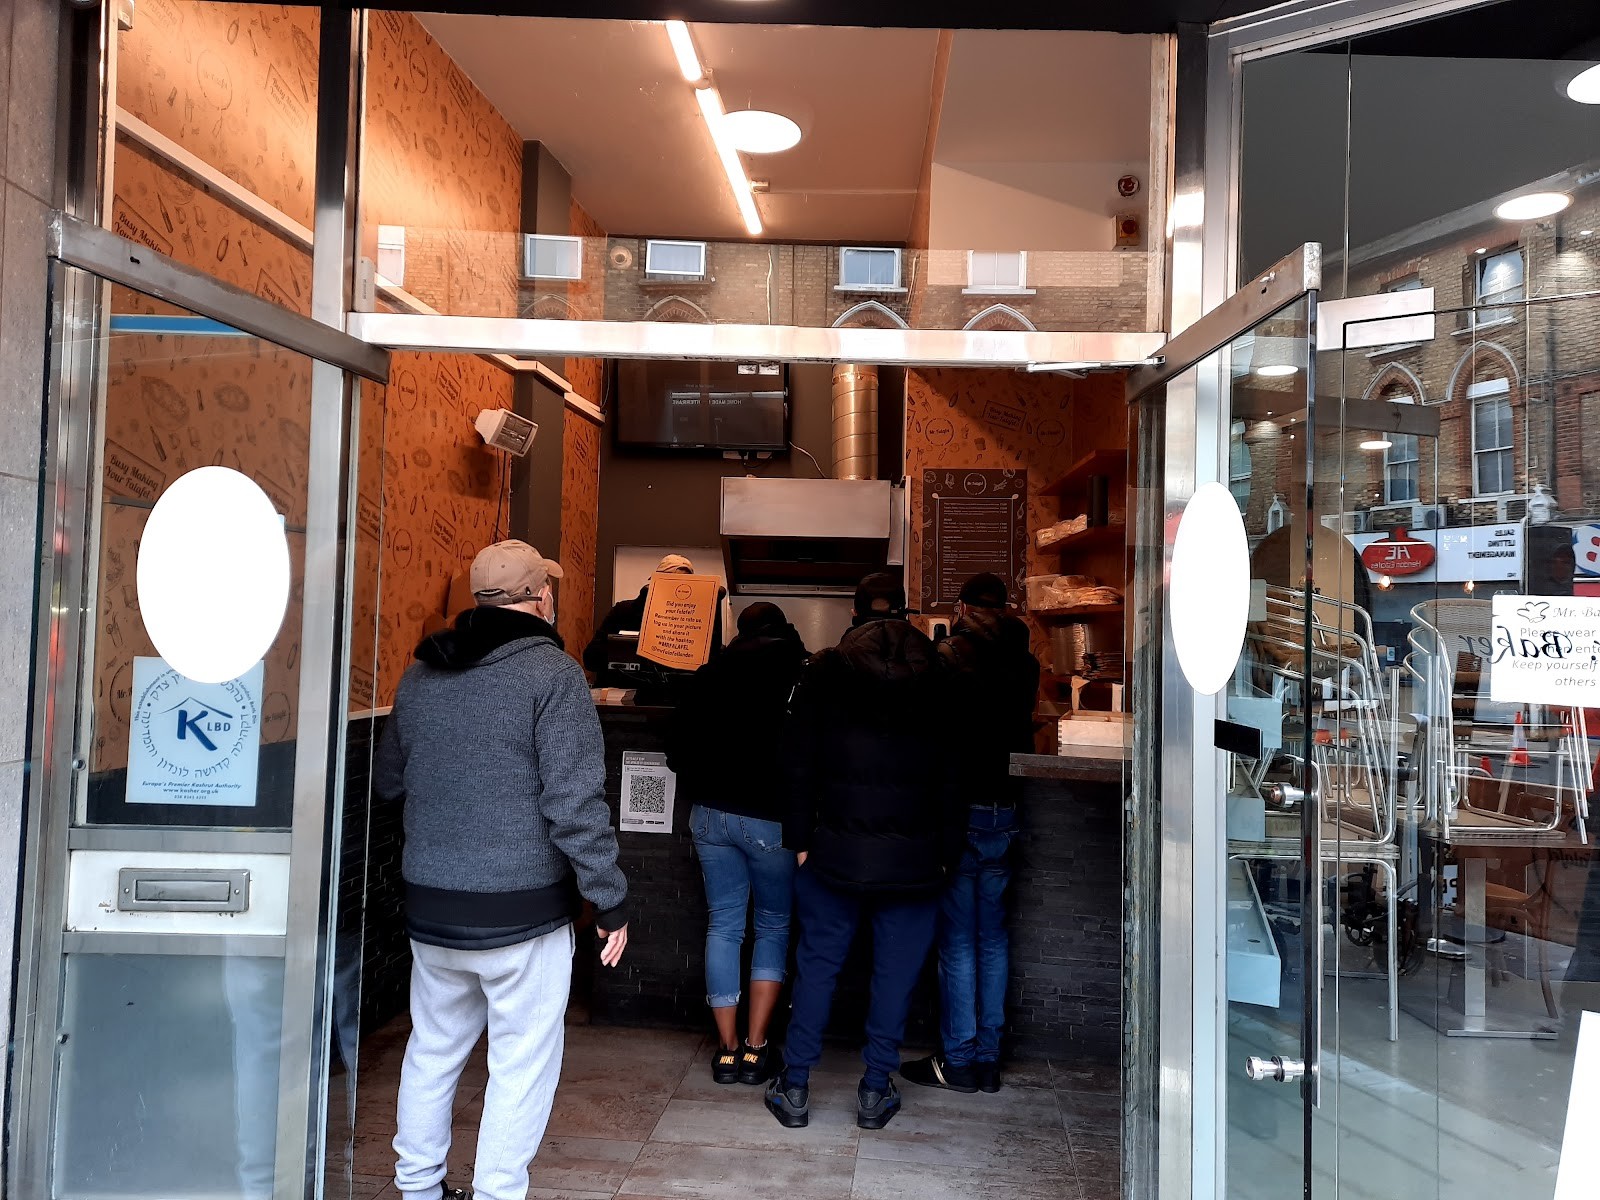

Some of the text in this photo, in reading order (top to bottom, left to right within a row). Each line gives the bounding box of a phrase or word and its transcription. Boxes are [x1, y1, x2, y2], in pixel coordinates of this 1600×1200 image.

[119, 211, 167, 256] Busy Makin
[105, 465, 125, 483] Your
[110, 454, 159, 492] Busy Making
[1552, 606, 1600, 618] Mr. Ba
[1520, 627, 1597, 638] Please wear
[1512, 657, 1599, 672] Keep yourself
[1554, 676, 1597, 687] others
[176, 709, 231, 752] K LBD
[719, 1055, 735, 1065] NIKE
[743, 1052, 758, 1064] NIKE
